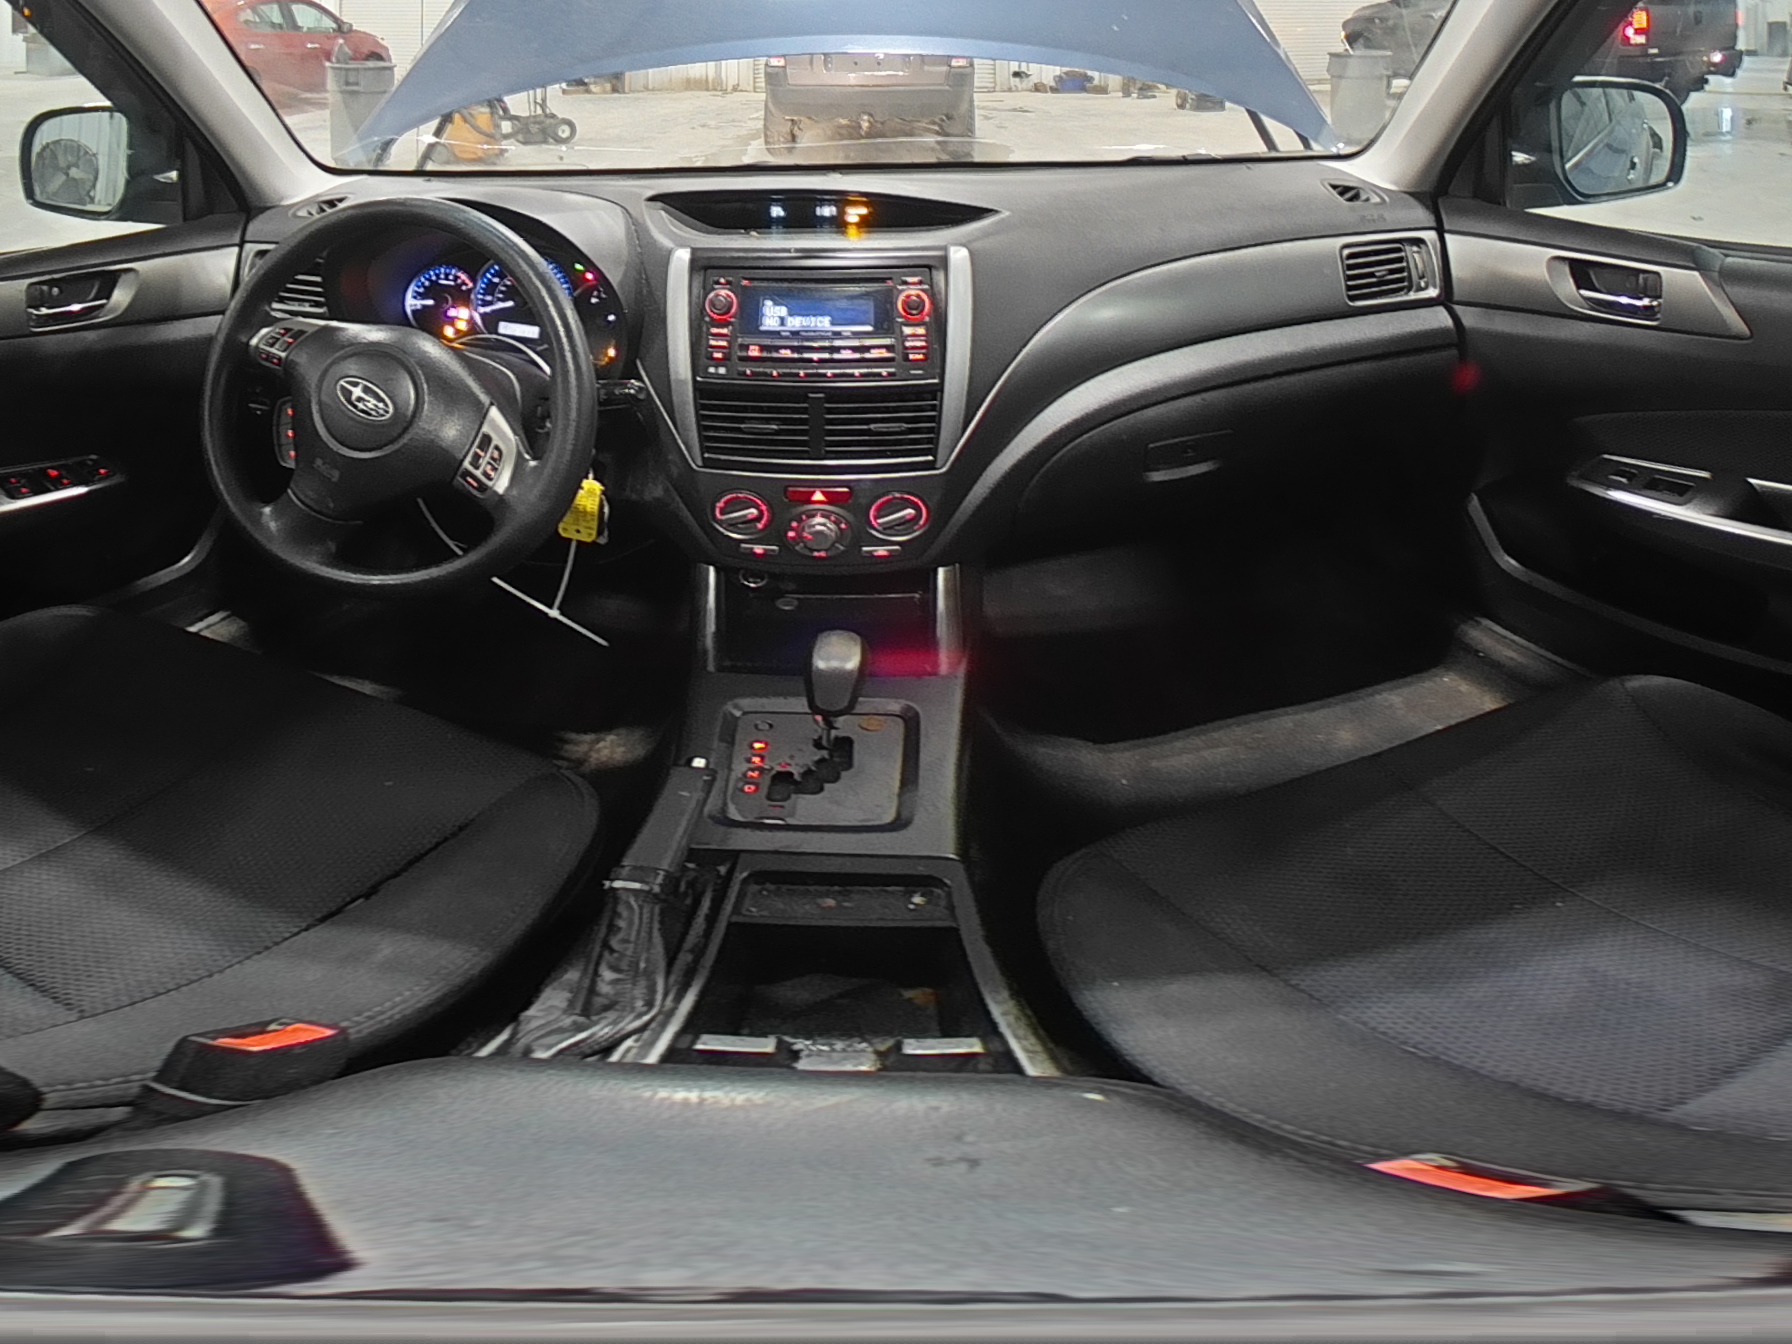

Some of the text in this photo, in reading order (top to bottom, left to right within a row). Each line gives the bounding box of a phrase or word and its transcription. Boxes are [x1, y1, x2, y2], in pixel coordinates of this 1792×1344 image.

[765, 306, 788, 316] USB
[765, 316, 832, 327] NO DEVICE
